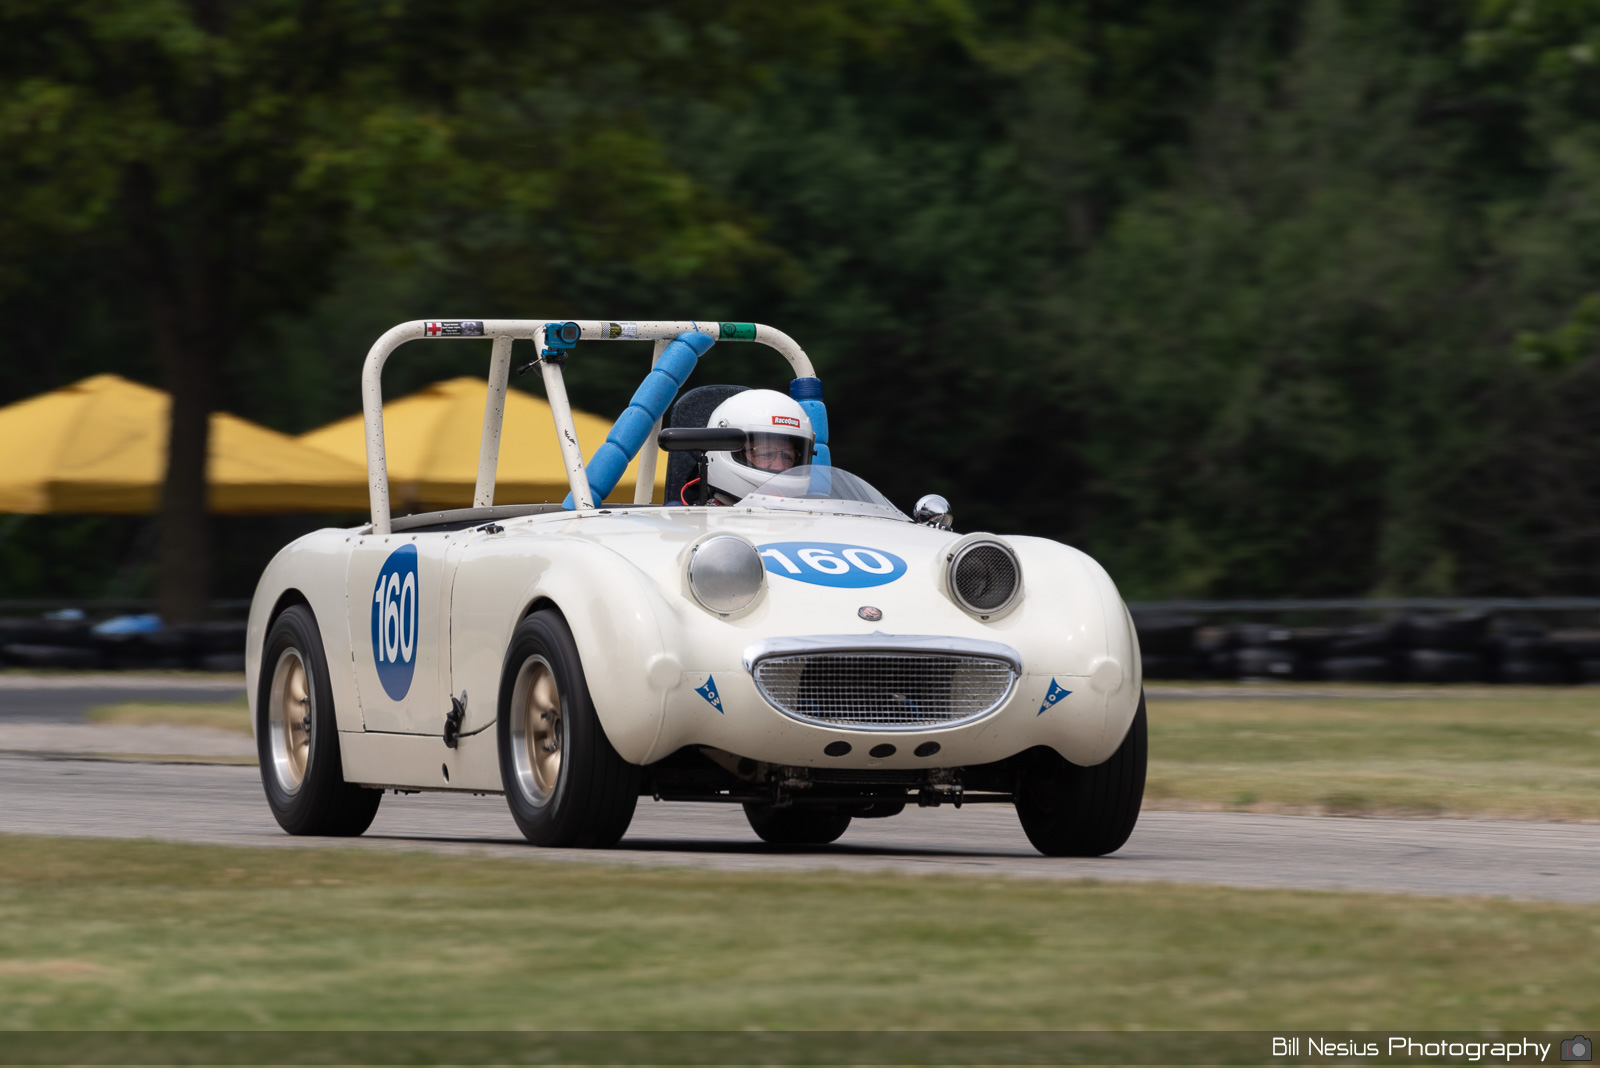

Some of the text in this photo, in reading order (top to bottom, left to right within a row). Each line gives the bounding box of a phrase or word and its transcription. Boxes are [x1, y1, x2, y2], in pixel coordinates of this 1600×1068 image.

[774, 416, 799, 426] RaceQuip
[761, 548, 895, 575] 160
[375, 571, 416, 664] 160
[703, 684, 720, 706] TOW
[1043, 686, 1062, 708] TOW
